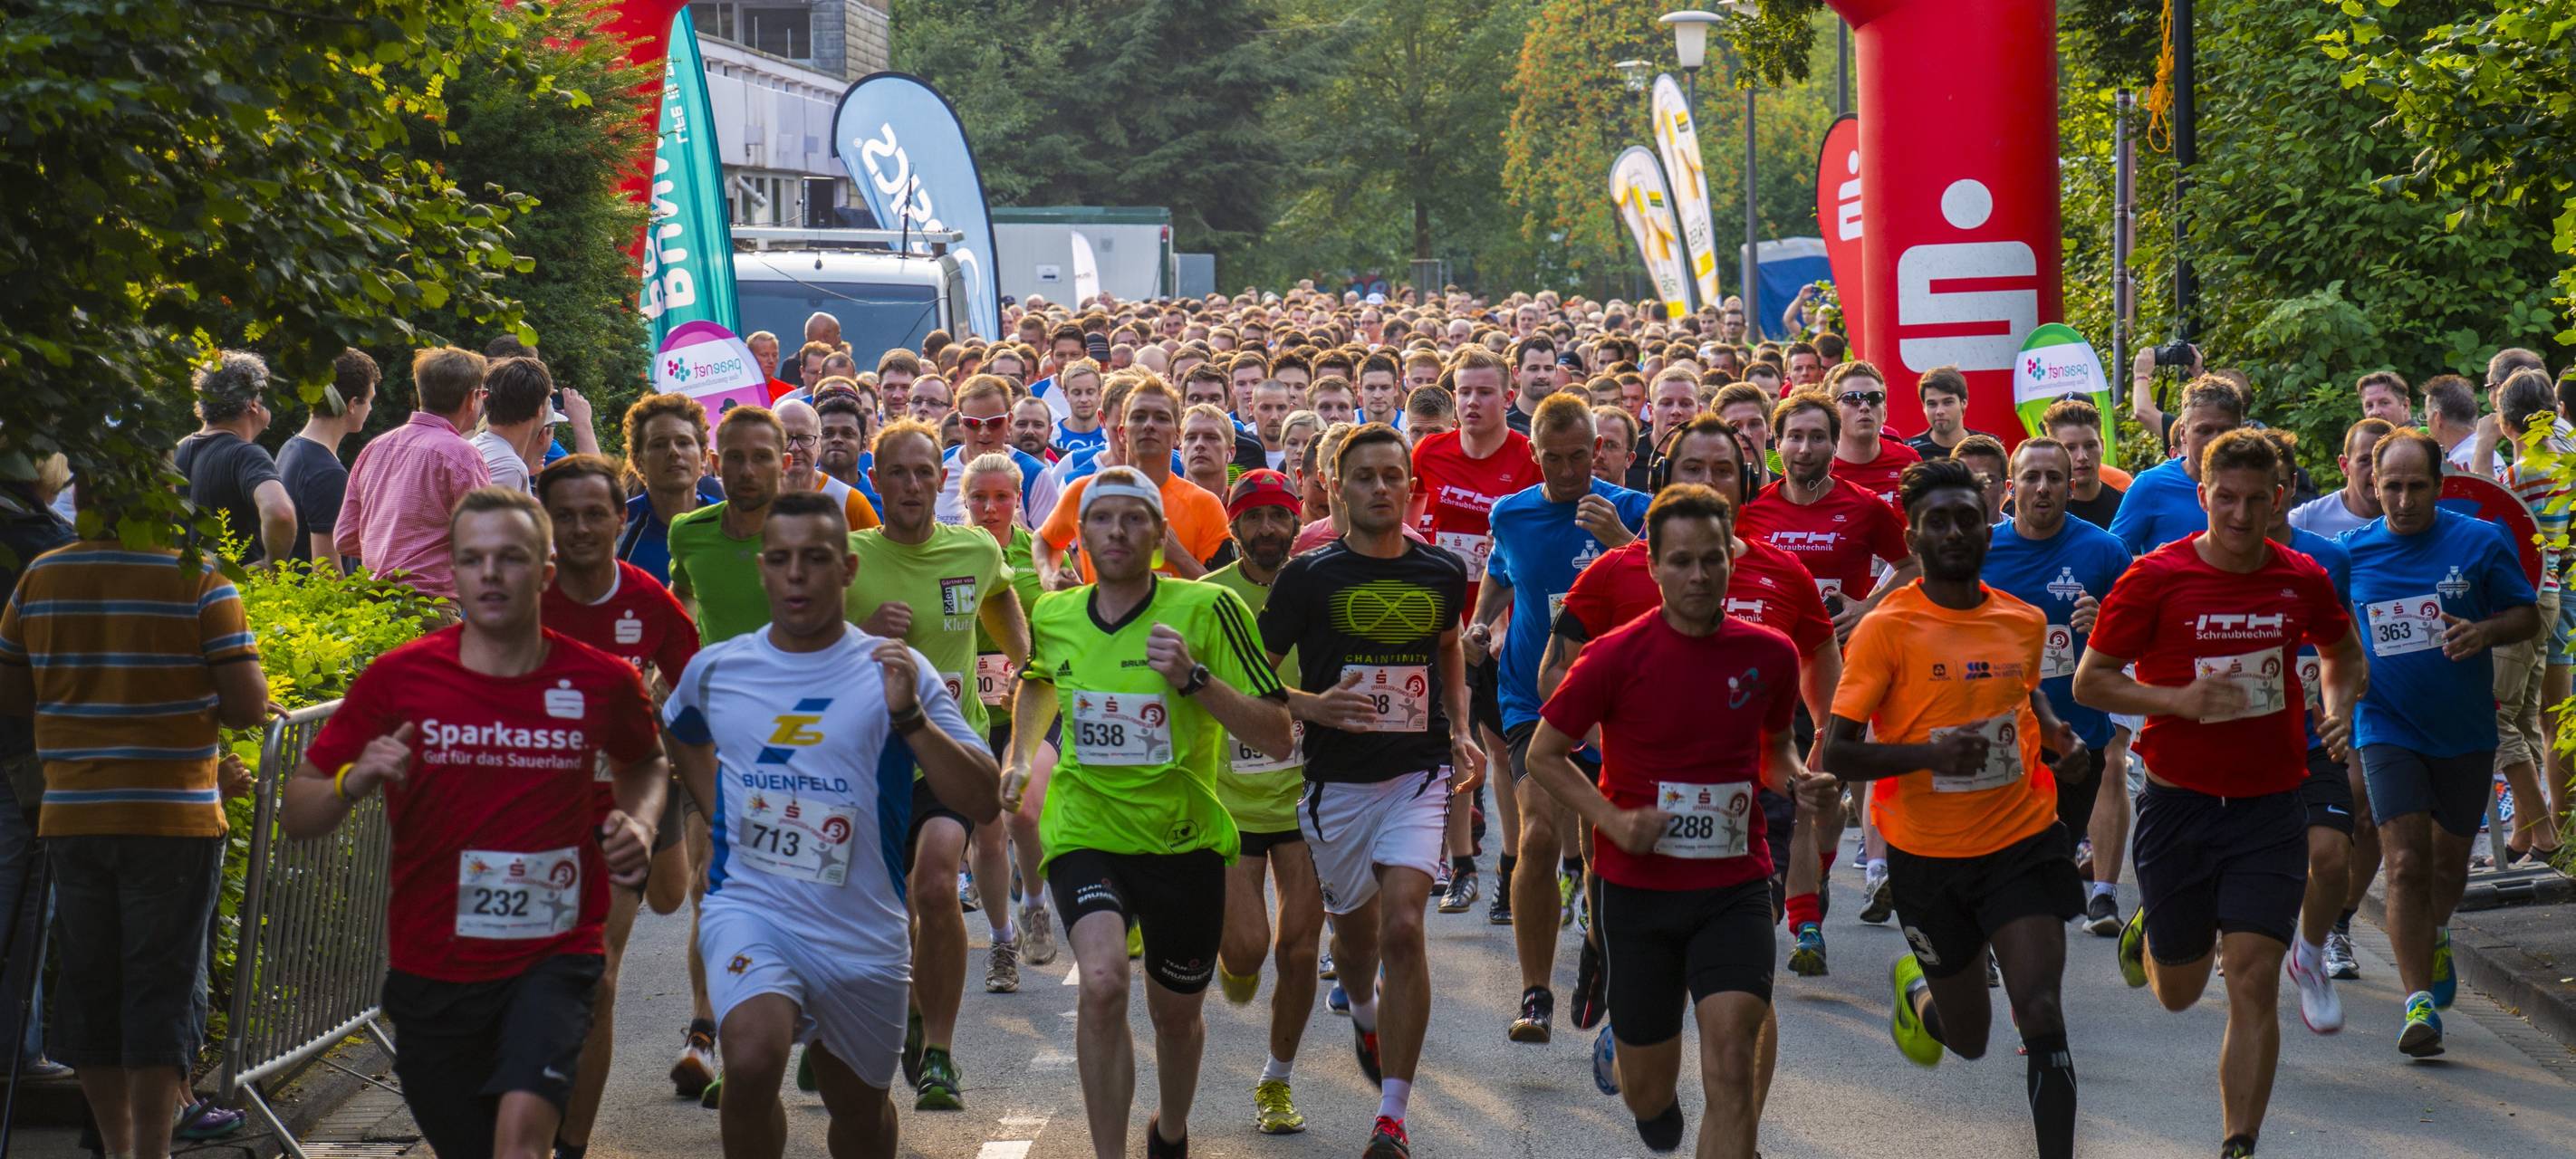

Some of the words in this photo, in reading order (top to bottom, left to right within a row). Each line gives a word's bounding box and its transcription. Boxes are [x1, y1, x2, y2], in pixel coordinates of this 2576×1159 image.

[2196, 628, 2283, 641] Schraubtechnik
[2379, 622, 2412, 643] 363
[1344, 654, 1428, 664] CHAINFINITY
[1082, 723, 1125, 747] 538
[423, 749, 447, 764] Gut
[450, 750, 472, 765] für
[476, 751, 504, 767] das
[1668, 815, 1714, 839] 288
[752, 823, 801, 857] 713
[1077, 884, 1102, 894] TEAM
[474, 887, 530, 917] 232
[1165, 959, 1187, 971] TEAM
